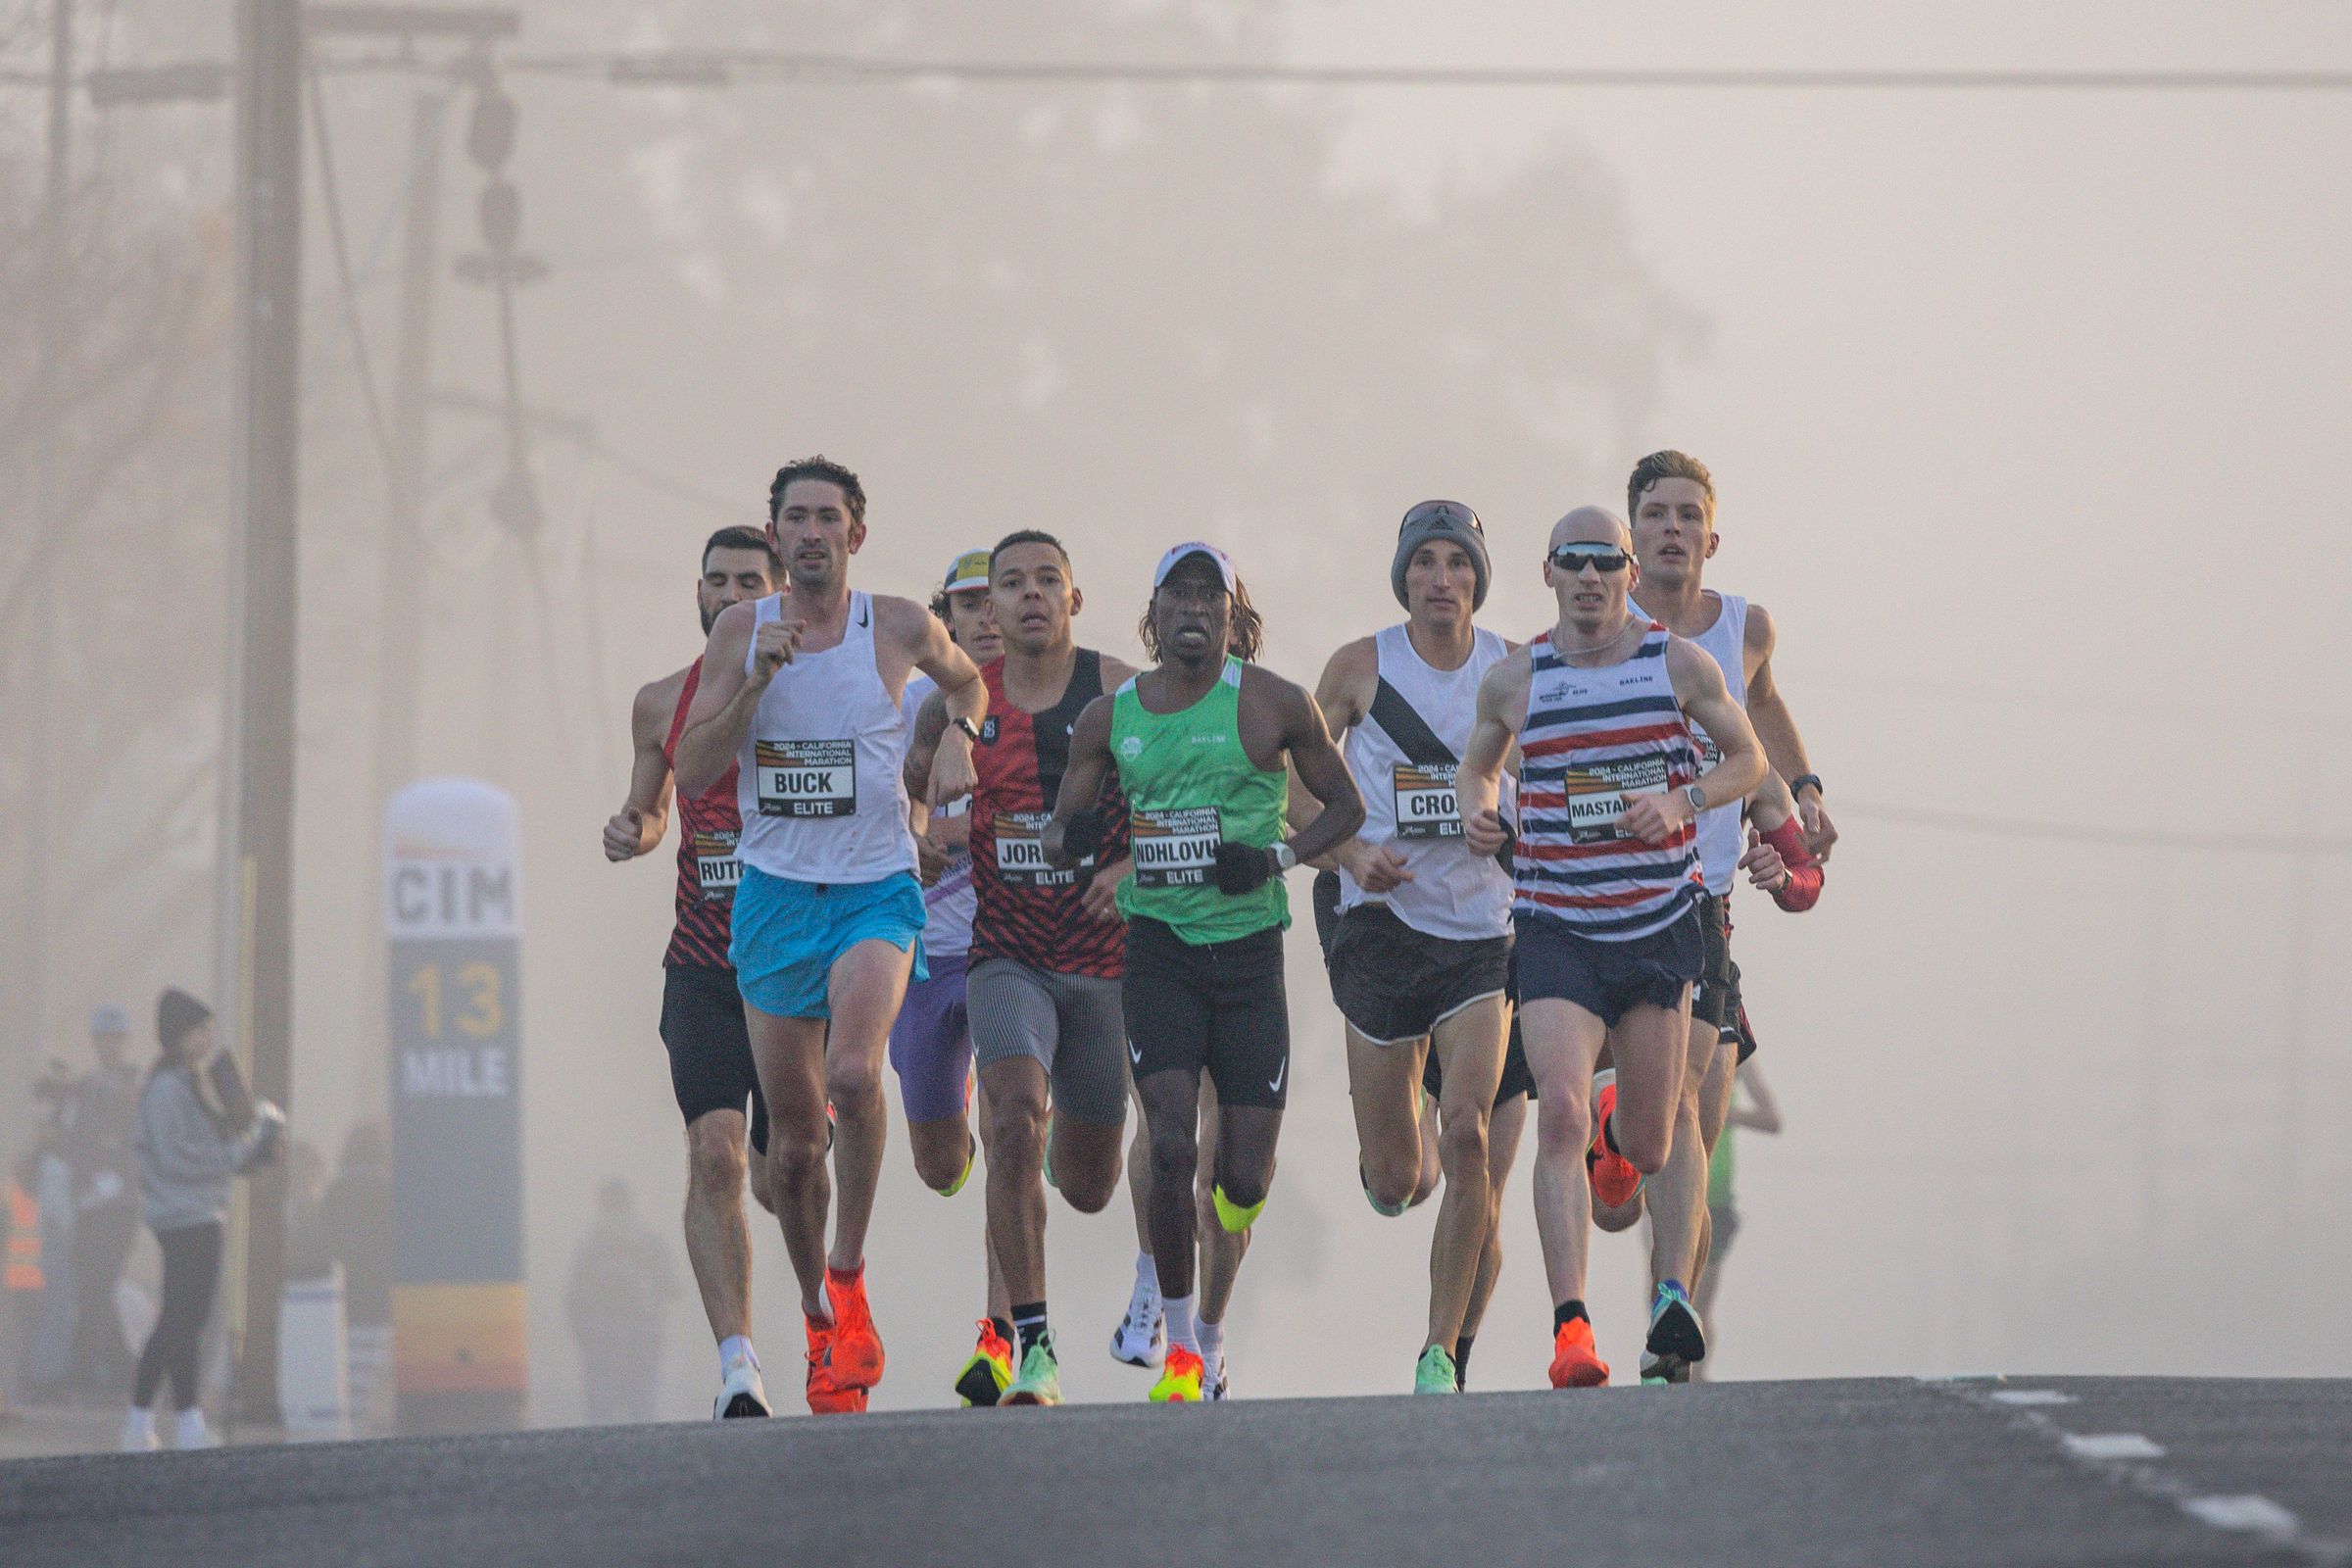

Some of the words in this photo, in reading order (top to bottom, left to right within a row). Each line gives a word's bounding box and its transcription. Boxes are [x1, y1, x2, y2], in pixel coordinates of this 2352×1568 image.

[1619, 676, 1653, 686] BAKLINE
[786, 750, 852, 759] INTERNATIONAL
[804, 758, 853, 766] MARATHON
[1617, 758, 1665, 772] CALIFORNIA
[774, 772, 833, 794] BUCK
[1602, 766, 1665, 783] INTERNATIONAL
[1621, 774, 1667, 789] MARATHON
[793, 802, 833, 815] ELITE
[1169, 807, 1217, 819] CALIFORNIA
[1411, 795, 1459, 815] CRO
[1156, 816, 1217, 827] INTERNATIONAL
[1172, 824, 1218, 834] MARATHON
[1002, 844, 1041, 863] JOR
[1136, 839, 1219, 862] NDHLOVU
[1035, 869, 1074, 886] ELITE
[1166, 868, 1203, 885] ELITE
[394, 864, 514, 926] CIM
[408, 961, 502, 1040] 13
[402, 1046, 508, 1098] MILE
